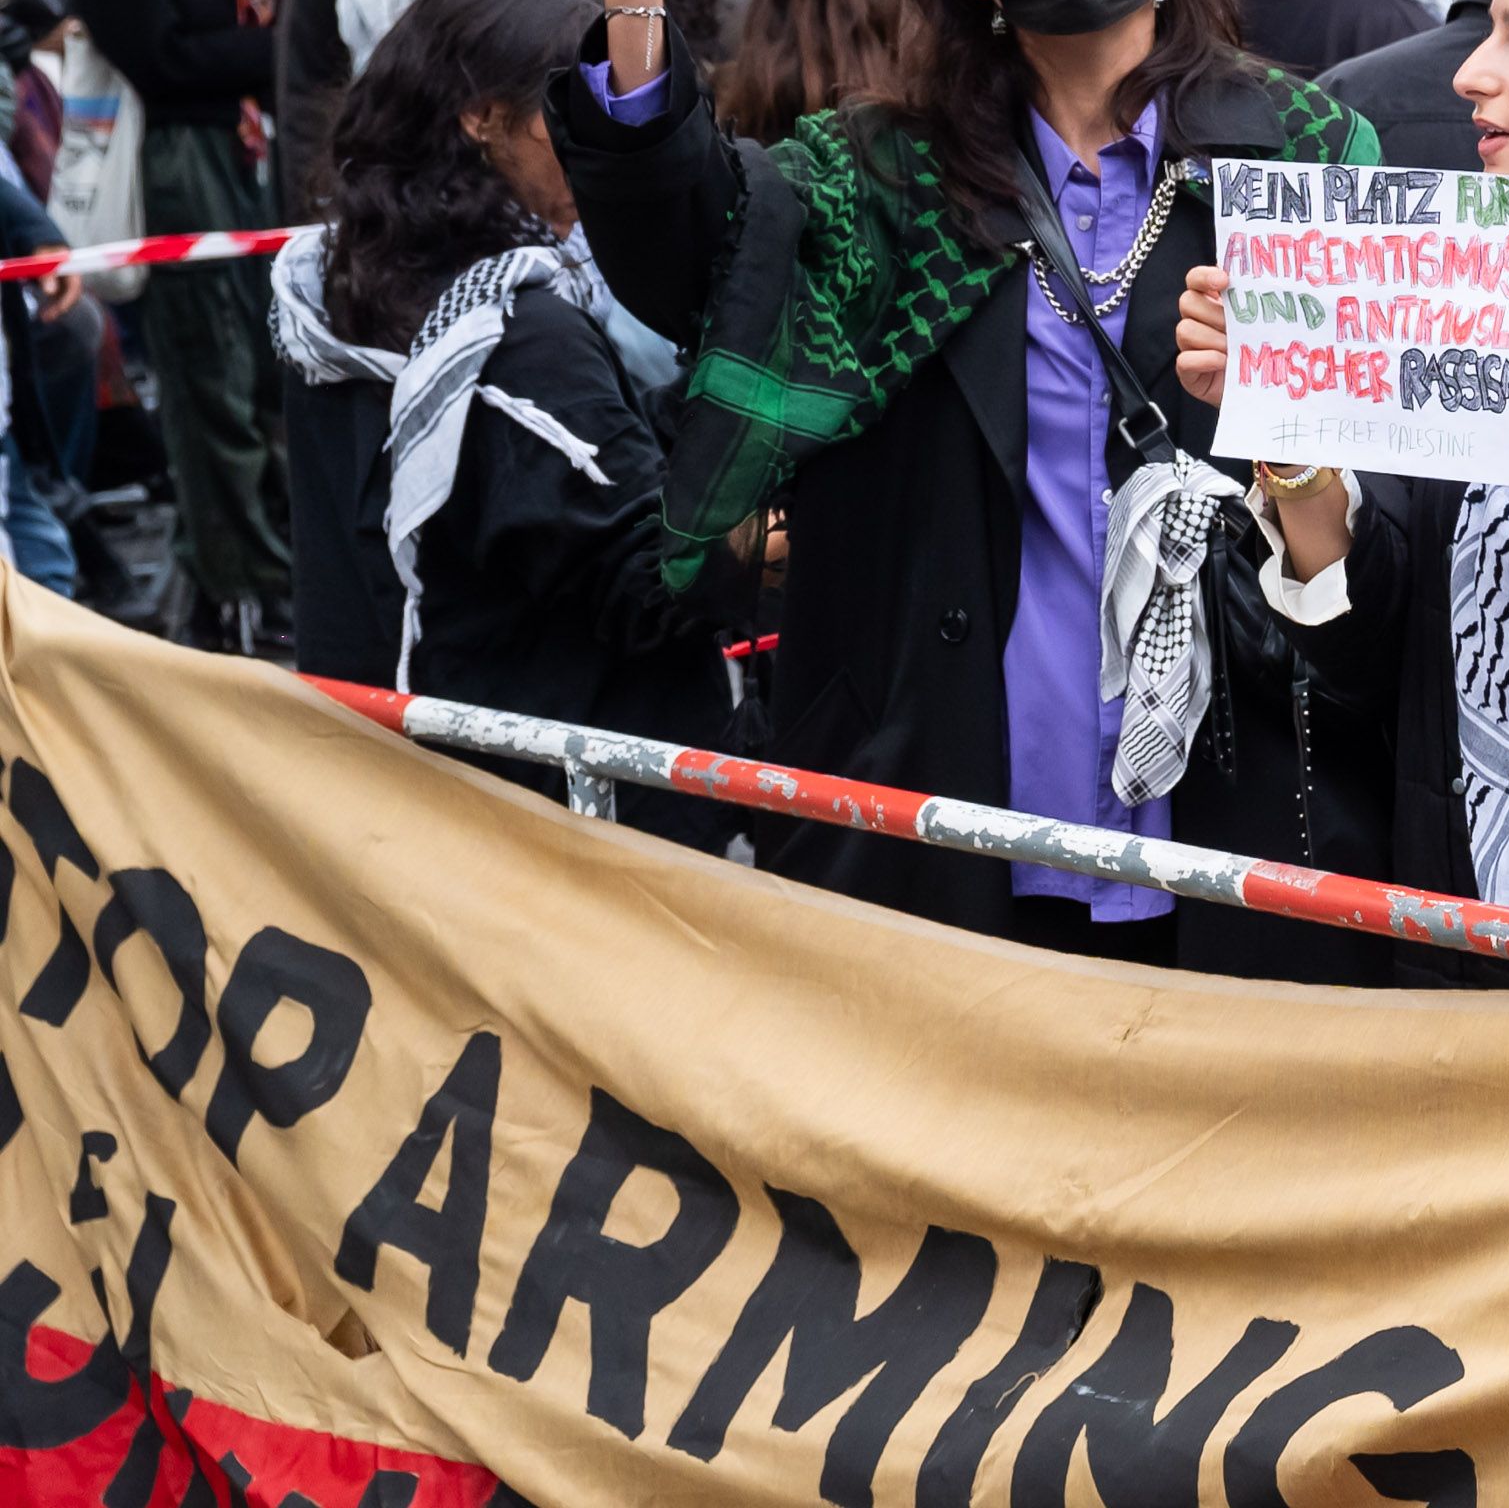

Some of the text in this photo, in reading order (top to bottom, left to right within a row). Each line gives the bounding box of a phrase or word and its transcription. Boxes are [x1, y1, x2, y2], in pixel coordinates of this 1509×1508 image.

[1218, 162, 1312, 223] KEIN
[1322, 165, 1444, 224] PLATZ
[1227, 288, 1327, 330] UND
[1239, 341, 1394, 403] MISCHER
[1388, 422, 1477, 458] PALESTINE
[0, 756, 373, 1171] TOP
[333, 1030, 1479, 1508] ARMING
